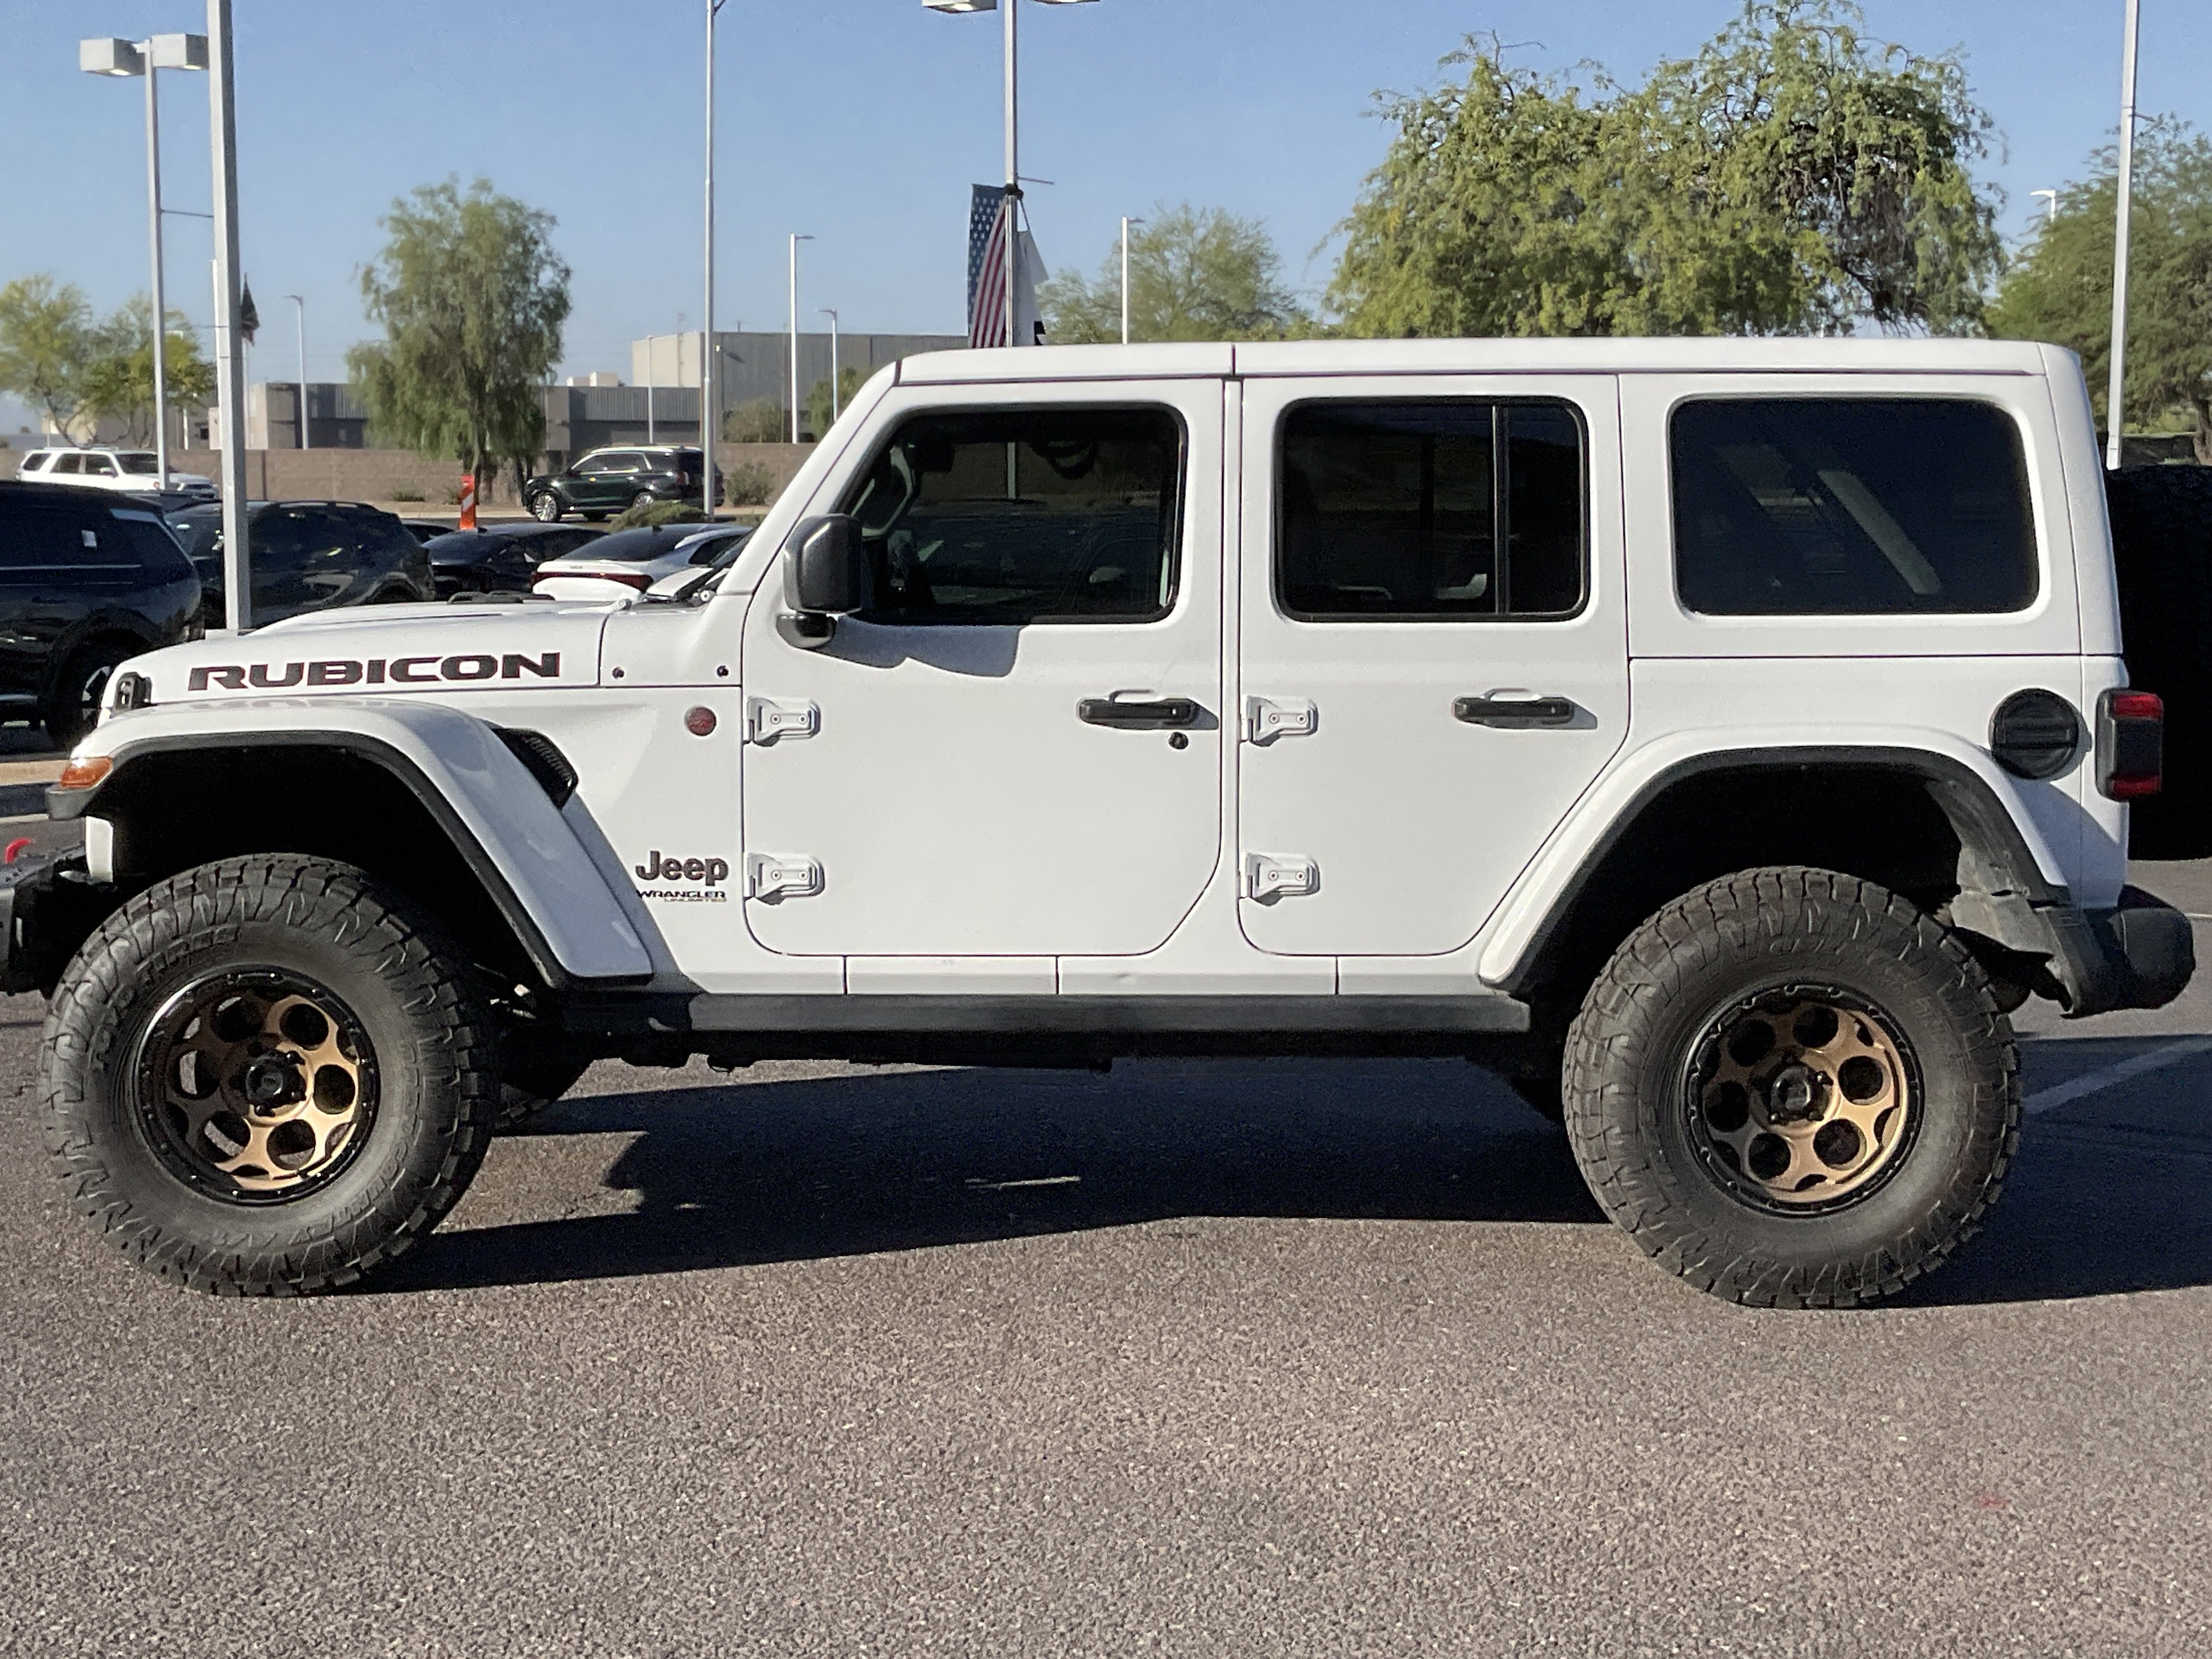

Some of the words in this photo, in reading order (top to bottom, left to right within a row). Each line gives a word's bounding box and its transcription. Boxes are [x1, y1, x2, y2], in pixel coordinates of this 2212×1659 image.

[188, 652, 560, 691] RUBICON
[635, 850, 729, 886] Jeep
[636, 890, 725, 898] WRANGLER
